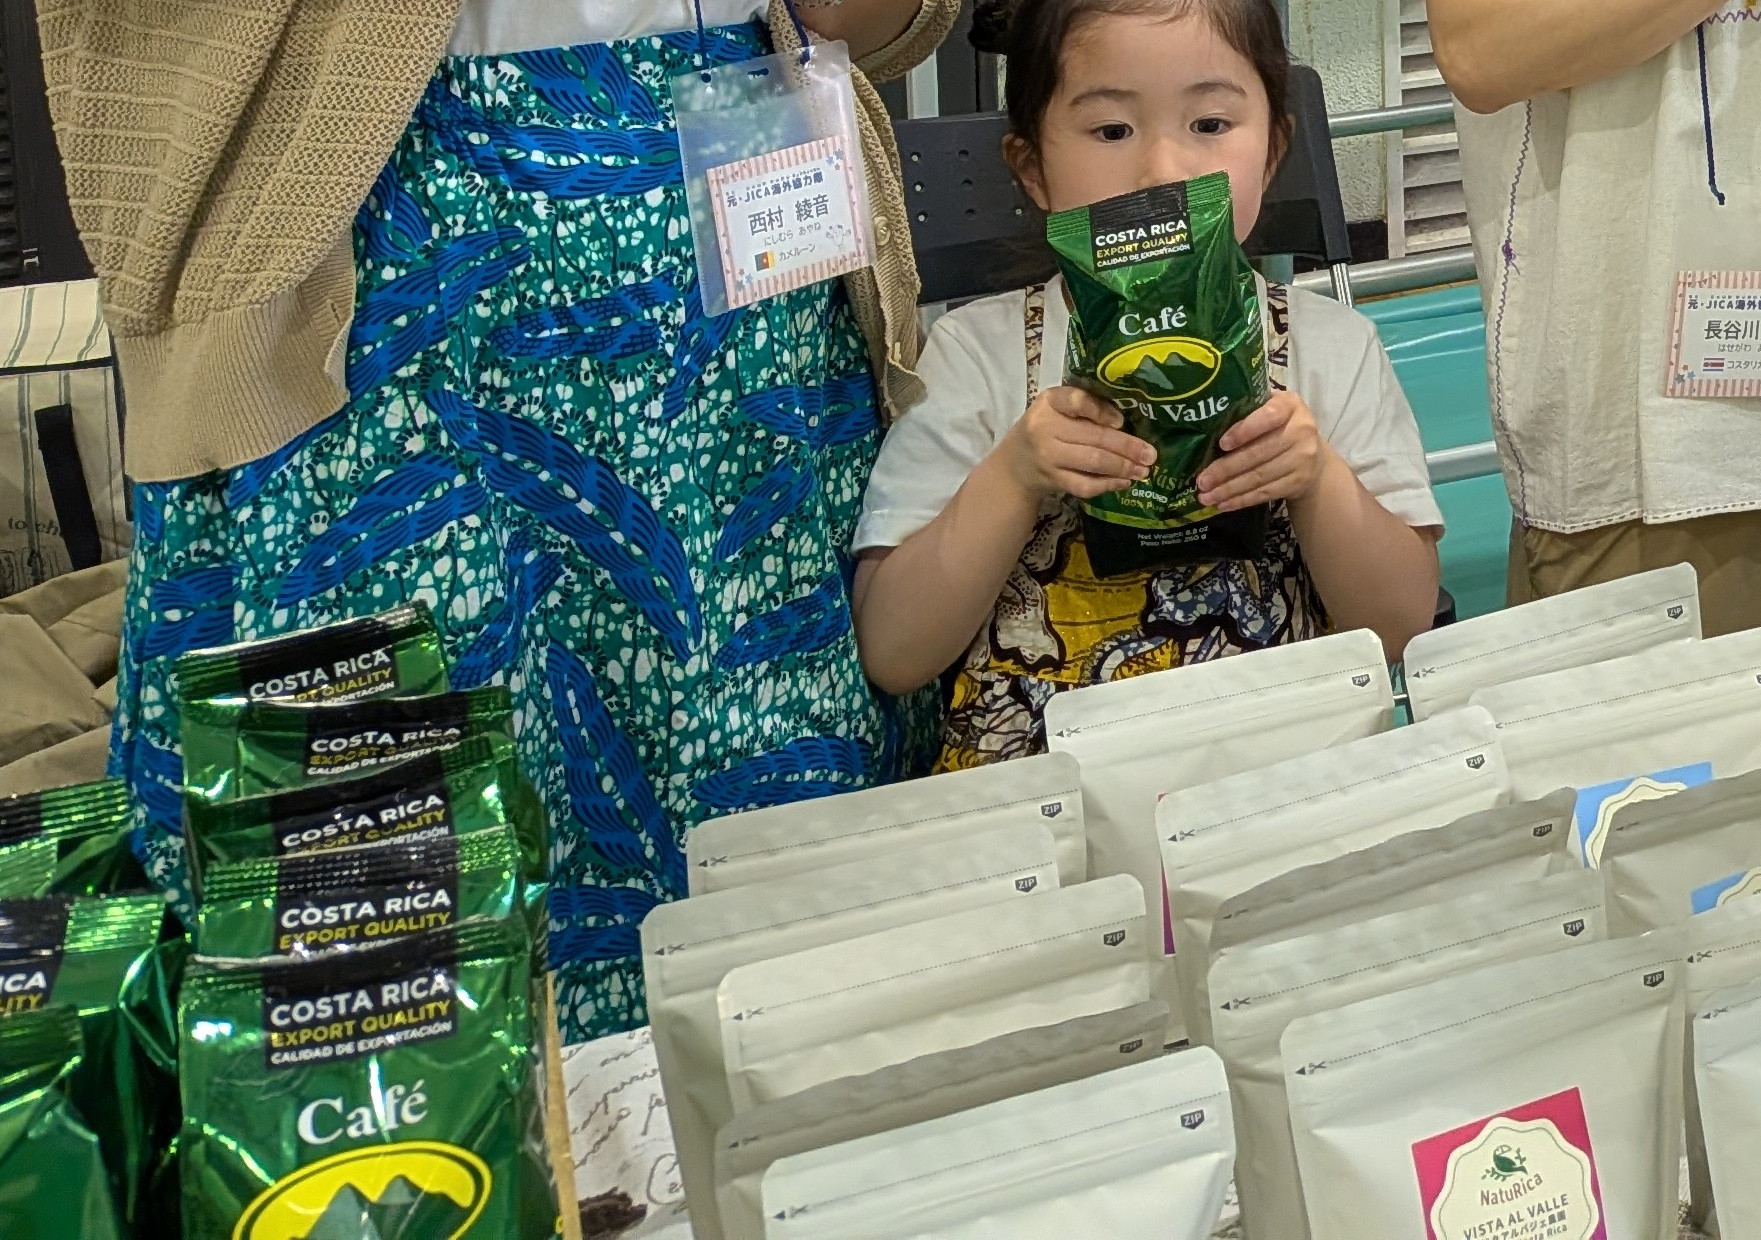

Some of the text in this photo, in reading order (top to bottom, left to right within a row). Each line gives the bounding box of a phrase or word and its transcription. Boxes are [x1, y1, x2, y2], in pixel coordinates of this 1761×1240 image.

[747, 193, 829, 237] 西村 綾音
[764, 230, 794, 247] にしむら
[1095, 219, 1188, 247] COSTA RICA
[1096, 233, 1189, 259] EXPORT QUALITY
[779, 243, 816, 262] カメルーン
[1096, 255, 1128, 268] CALIDAD
[1118, 305, 1188, 336] Café
[1704, 320, 1760, 341] 長谷川
[1717, 343, 1752, 353] はせがわ
[1112, 395, 1230, 423] Del Valle
[250, 667, 329, 699] COSTA
[333, 647, 391, 677] RICA
[321, 667, 392, 697] QUALITY
[1353, 674, 1369, 685] ZIP
[310, 726, 461, 753] COSTA RICA
[306, 756, 379, 775] CALIDAD DE
[309, 746, 381, 766] EXPORT
[1467, 756, 1484, 766] ZIP
[282, 793, 445, 848] COSTA RICA
[280, 888, 451, 929] COSTA RICA
[279, 924, 359, 950] EXPORT
[363, 911, 451, 936] QUALITY
[1106, 932, 1124, 943] ZIP
[1565, 921, 1583, 933] ZIP
[1645, 972, 1664, 984] ZIP
[270, 976, 451, 1027] COSTA RICA
[270, 999, 451, 1049] EXPORT QUALITY
[270, 1047, 334, 1066] CALIDAD
[335, 1042, 355, 1055] DE
[297, 1079, 428, 1145] Café
[1183, 1111, 1203, 1124] ZIP
[1480, 1173, 1544, 1206] NatuRica
[1463, 1217, 1505, 1240] VISTA
[1508, 1210, 1525, 1226] AL
[1526, 1193, 1569, 1218] VALLE
